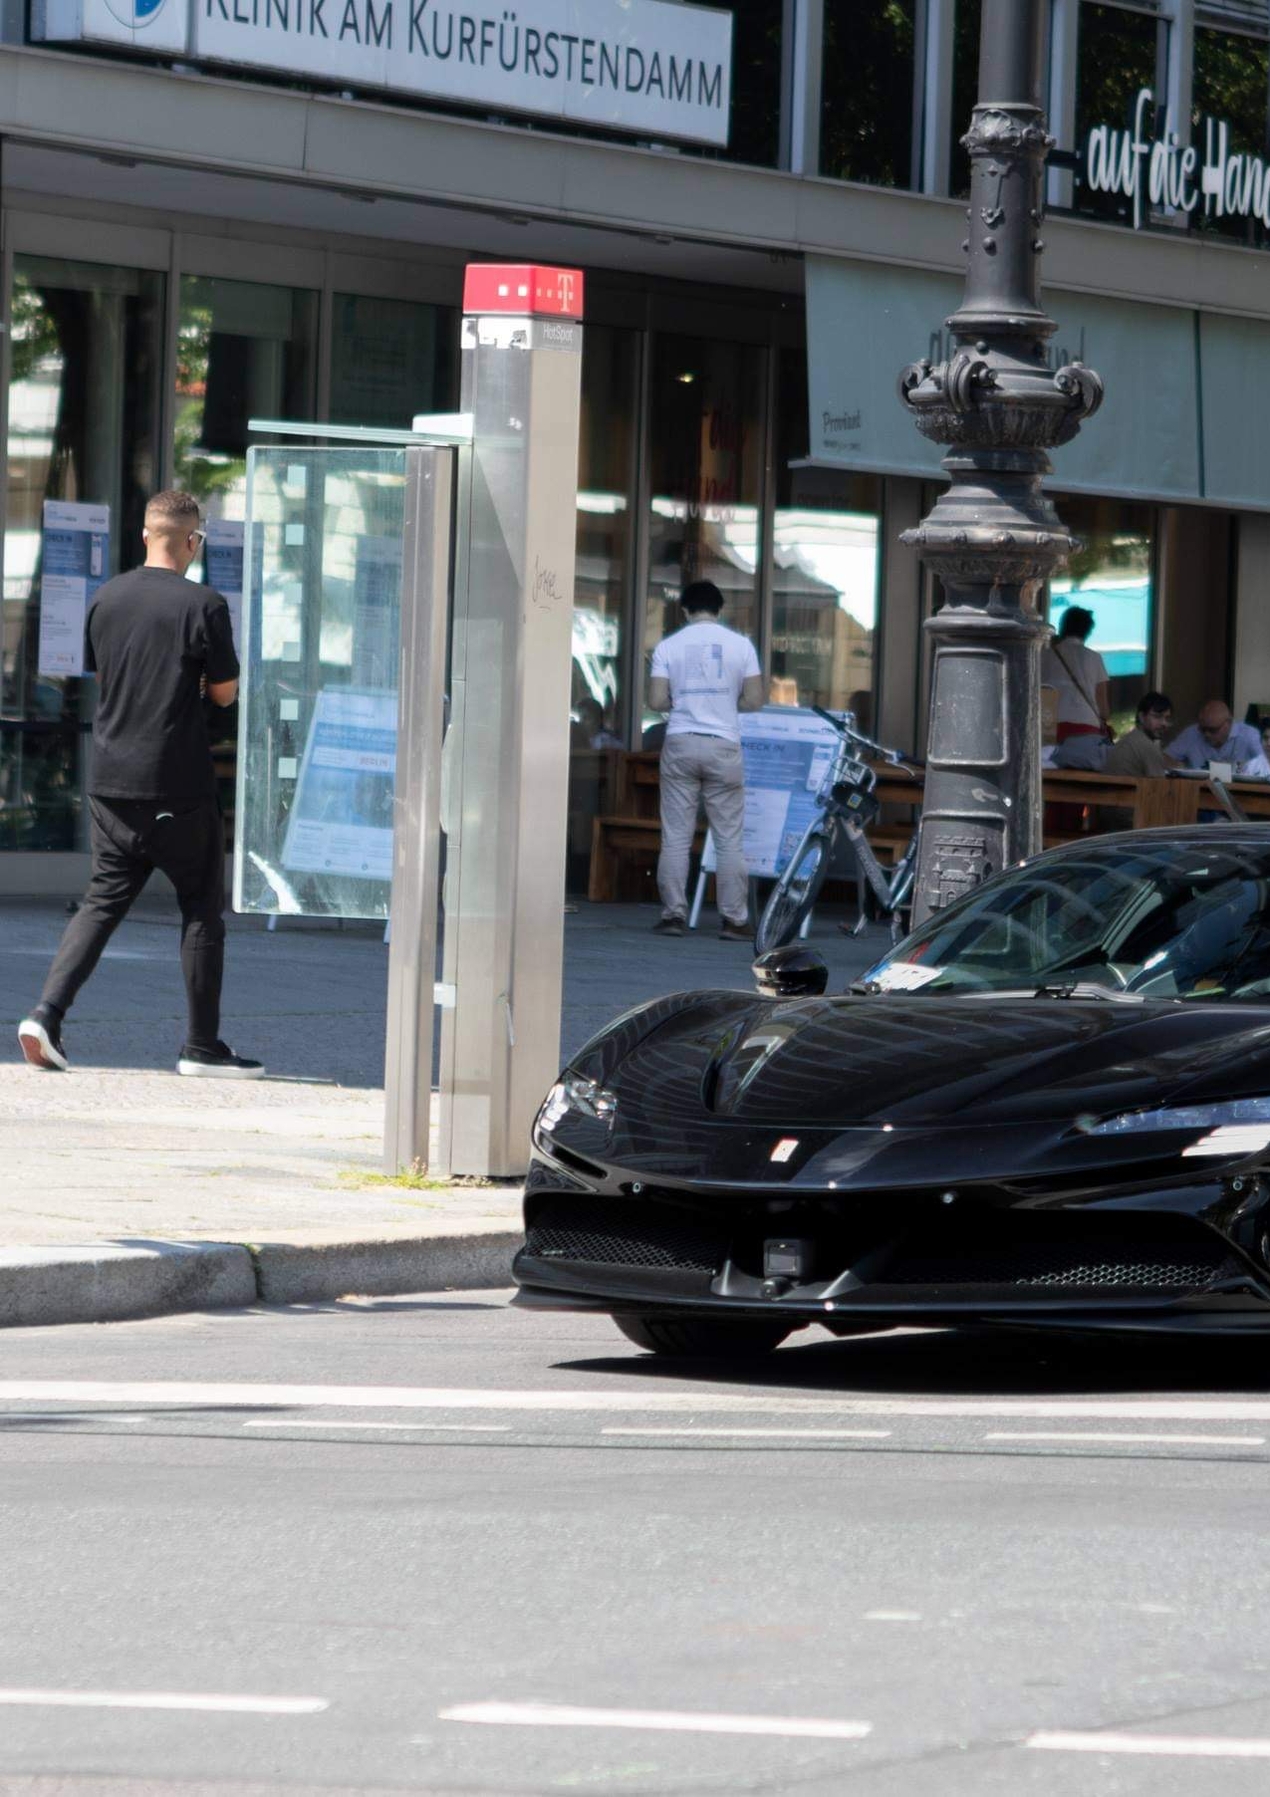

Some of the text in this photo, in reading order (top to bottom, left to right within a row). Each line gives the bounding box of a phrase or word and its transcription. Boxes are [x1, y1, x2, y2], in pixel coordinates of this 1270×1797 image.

[338, 0, 394, 50] AM
[408, 0, 724, 109] KURFÜRSTENDAMM
[1087, 88, 1152, 231] auf
[1149, 104, 1198, 212] die
[542, 322, 574, 345] HotSpot
